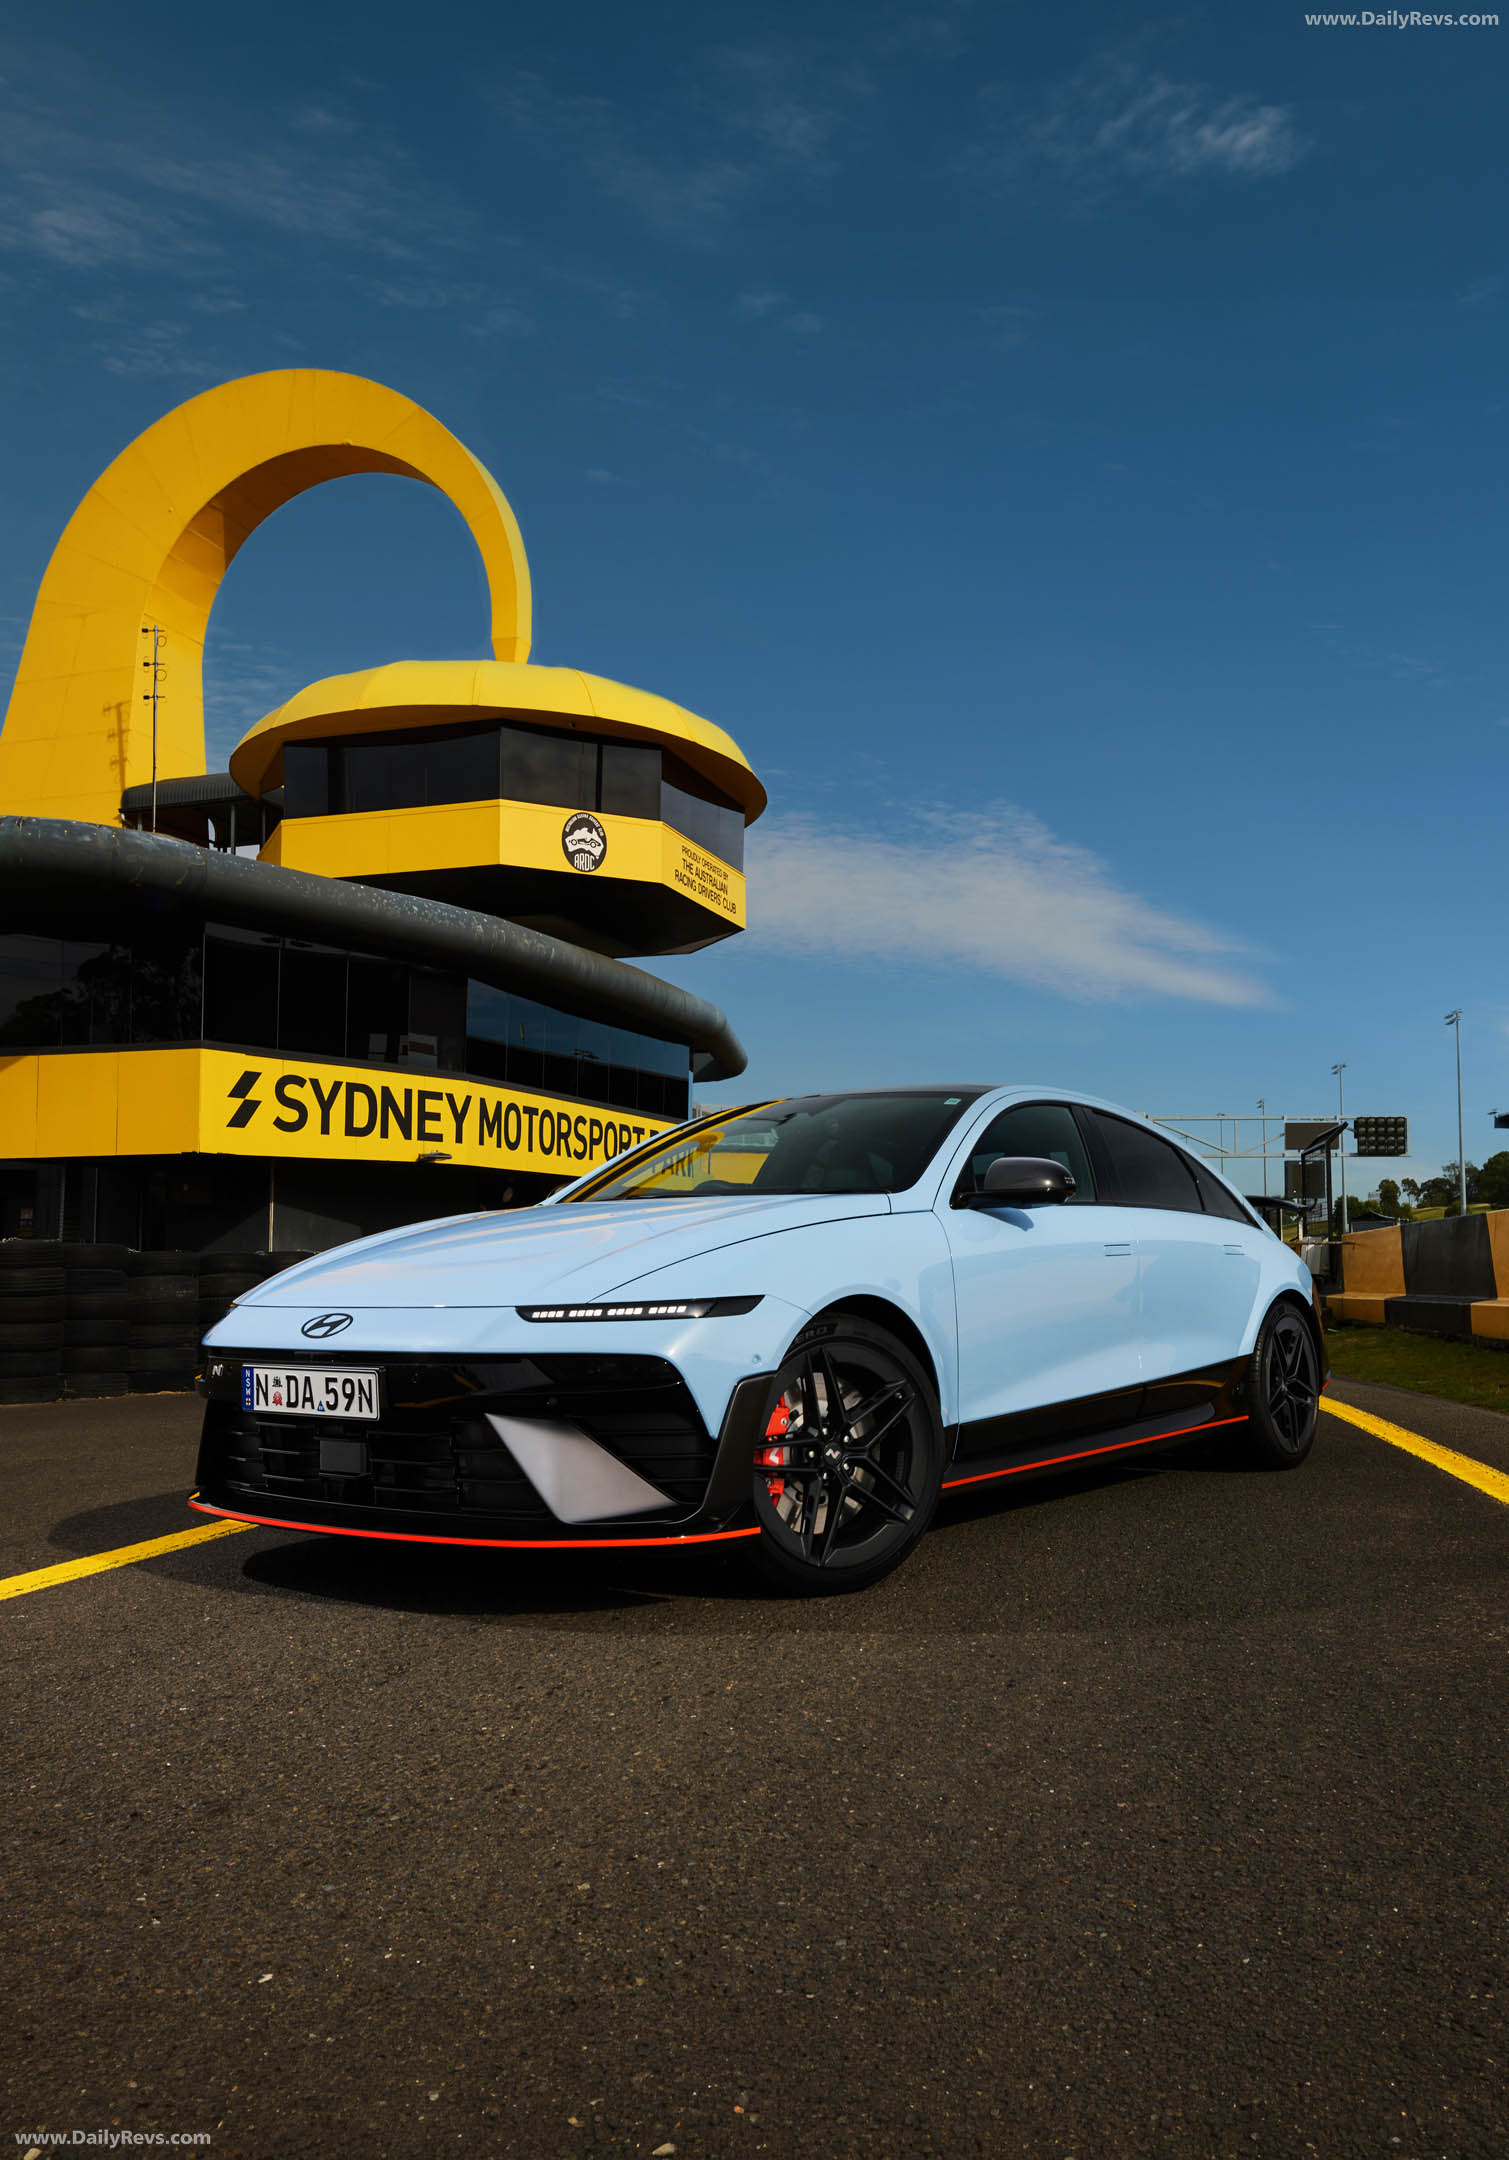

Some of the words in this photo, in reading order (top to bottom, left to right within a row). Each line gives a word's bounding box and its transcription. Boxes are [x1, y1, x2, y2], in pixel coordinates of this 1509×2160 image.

[574, 852, 596, 871] ARDC
[682, 857, 694, 876] THE
[695, 866, 728, 896] AUSTRALIAN
[675, 868, 697, 892] RACING
[723, 896, 737, 914] CLUB
[273, 1074, 472, 1144] SYDNEY
